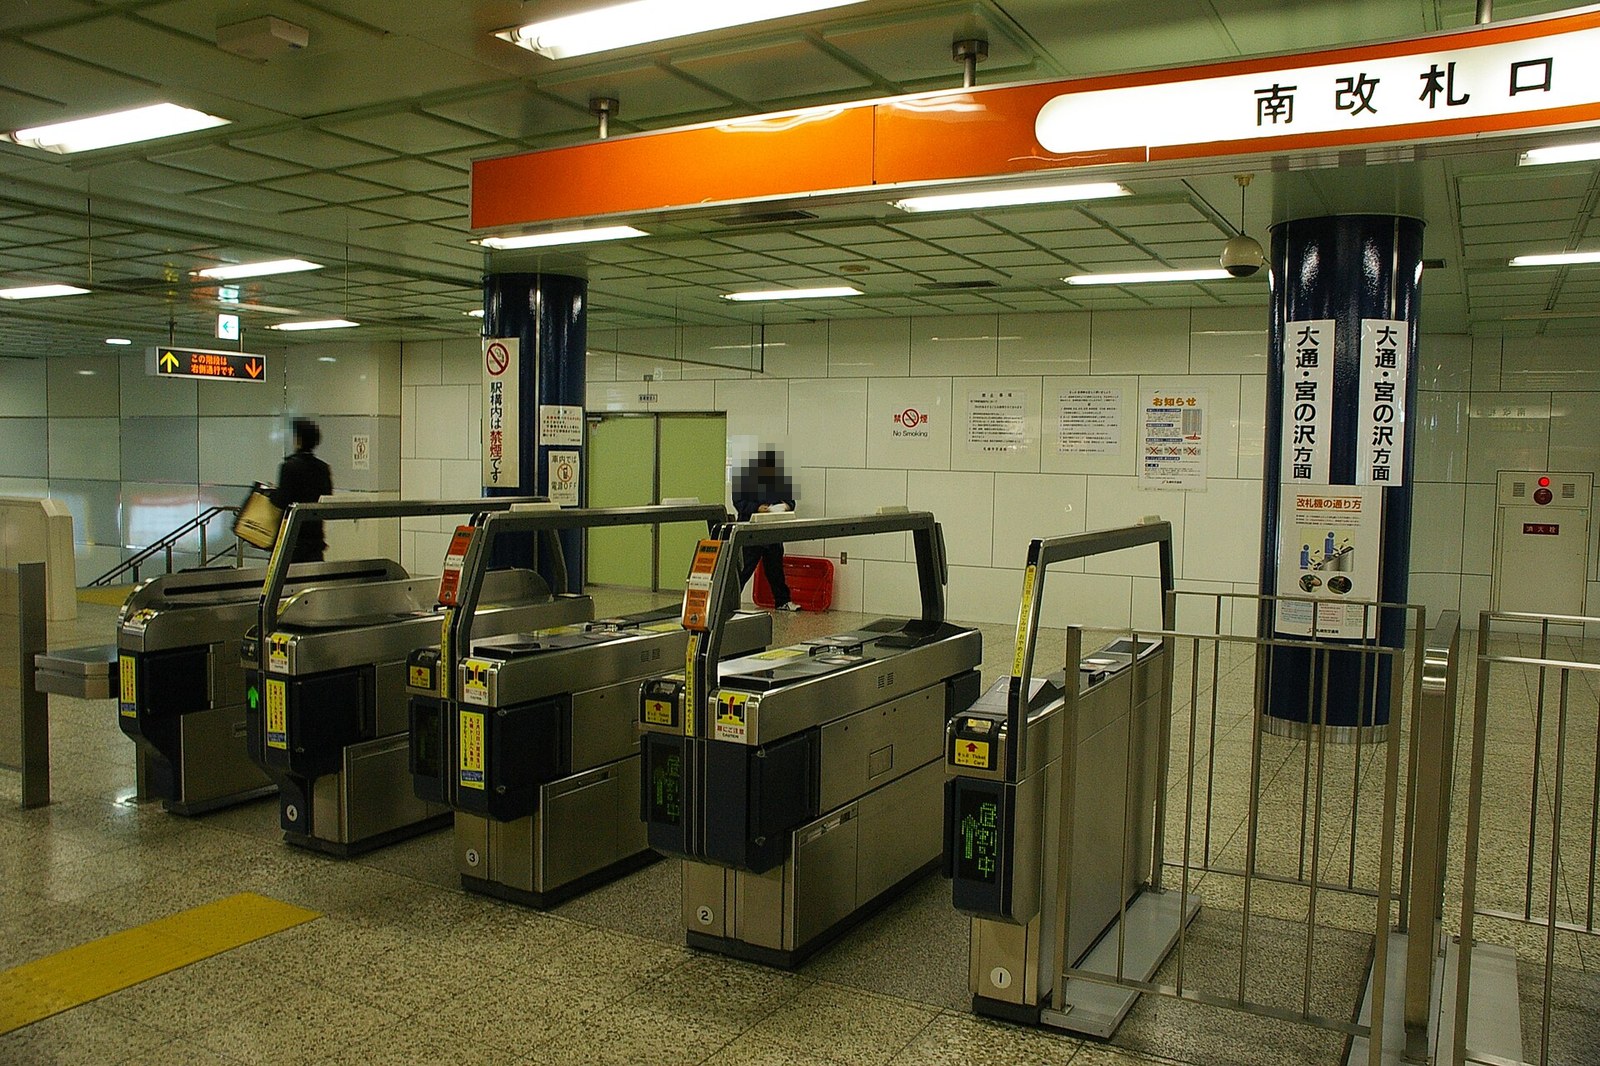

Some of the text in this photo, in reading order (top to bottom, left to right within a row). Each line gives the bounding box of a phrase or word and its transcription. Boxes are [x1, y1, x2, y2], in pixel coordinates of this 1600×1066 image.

[1254, 57, 1553, 126] 南改札口
[1153, 397, 1197, 407] お知らせ
[1293, 326, 1320, 479] 大通・宮の沢方面
[1371, 326, 1398, 481] 大通・宮の沢方面
[489, 381, 503, 484] 駅構内は禁煙です
[1296, 498, 1362, 510] 改札機の通り方
[469, 852, 476, 863] 3
[701, 910, 709, 921] 2
